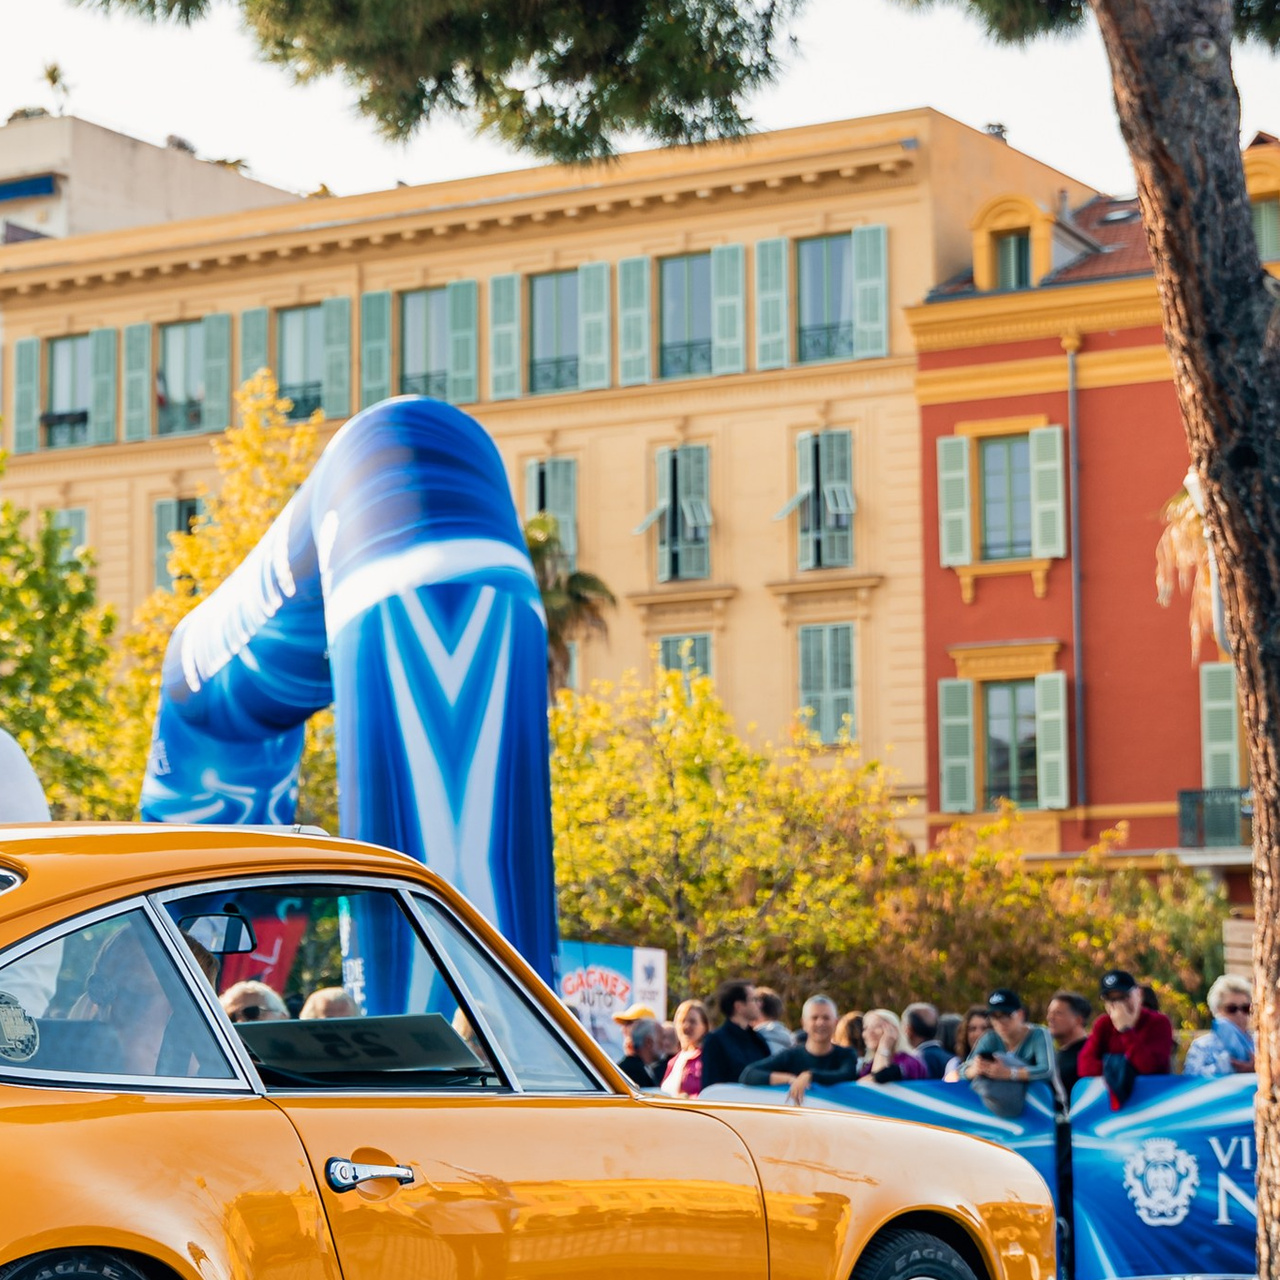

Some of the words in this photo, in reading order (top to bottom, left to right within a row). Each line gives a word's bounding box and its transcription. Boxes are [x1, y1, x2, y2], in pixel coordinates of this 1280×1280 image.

[562, 969, 631, 1002] GAGNEZ
[580, 991, 614, 1008] AUTO
[1208, 1136, 1252, 1169] VI
[1213, 1172, 1258, 1225] N
[895, 1248, 964, 1272] EAGLE
